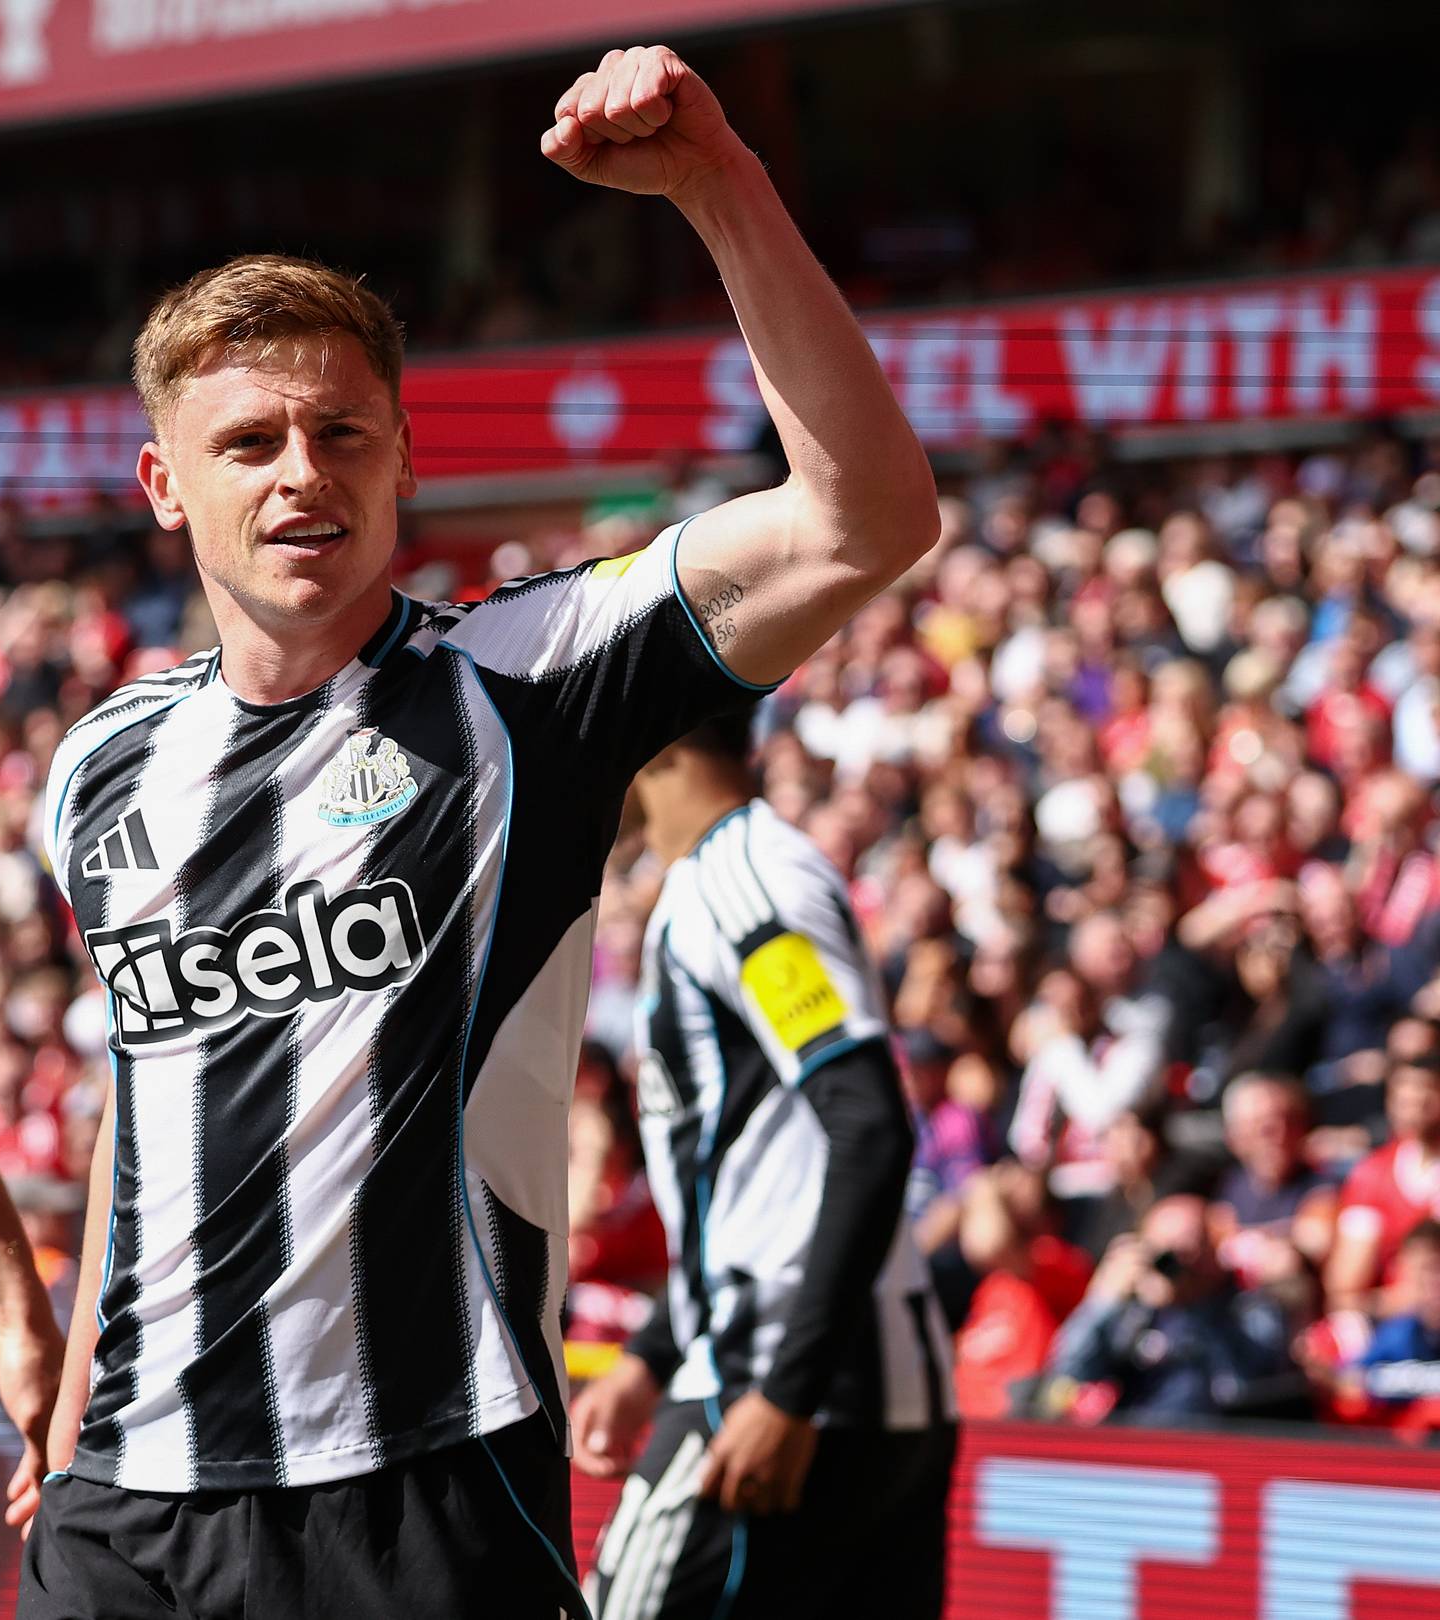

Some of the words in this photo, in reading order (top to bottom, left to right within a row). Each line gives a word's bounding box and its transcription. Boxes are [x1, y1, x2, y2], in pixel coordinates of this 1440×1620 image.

[1059, 280, 1376, 426] WITH
[699, 584, 743, 624] 2020
[179, 892, 412, 1018] sela
